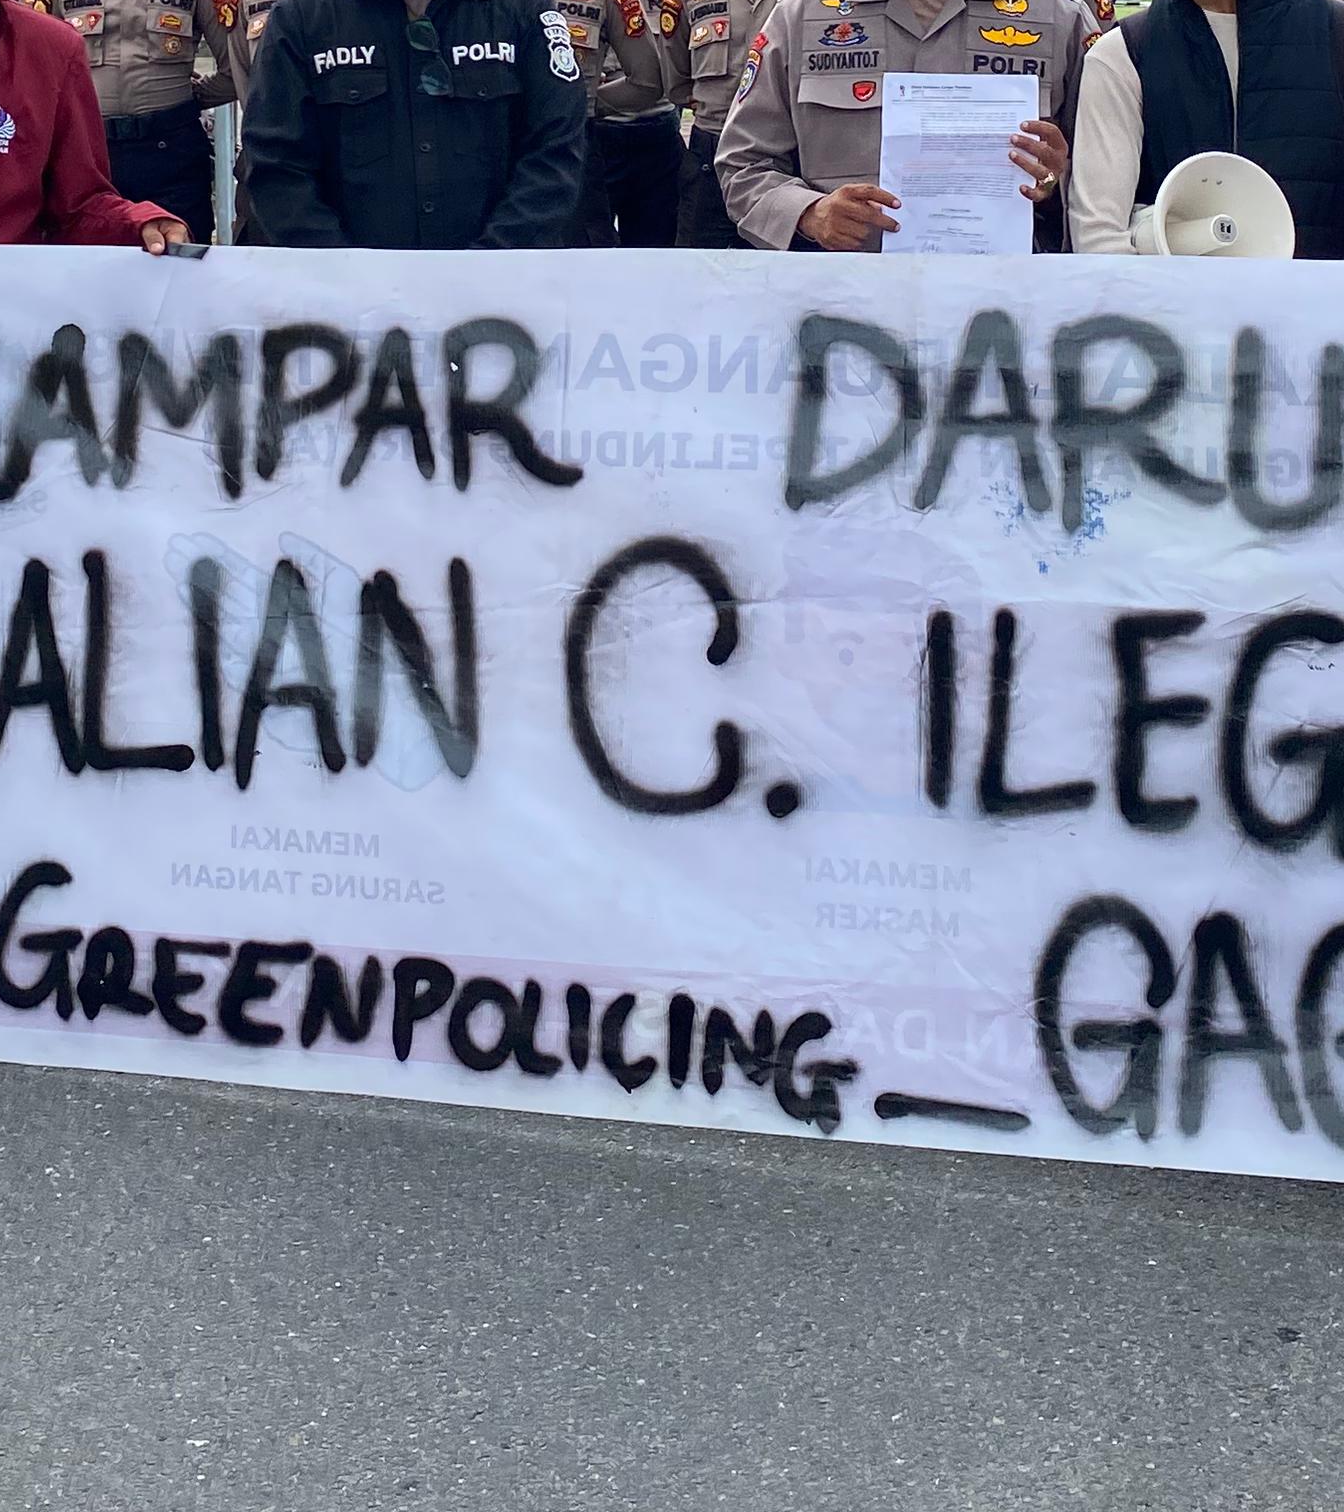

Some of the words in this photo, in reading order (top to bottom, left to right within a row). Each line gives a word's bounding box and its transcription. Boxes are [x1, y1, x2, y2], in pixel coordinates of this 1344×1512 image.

[558, 2, 601, 21] POLRI
[313, 45, 376, 74] FADLY
[452, 42, 515, 65] POLRI
[973, 54, 1045, 78] POLRI
[565, 534, 802, 820] C.
